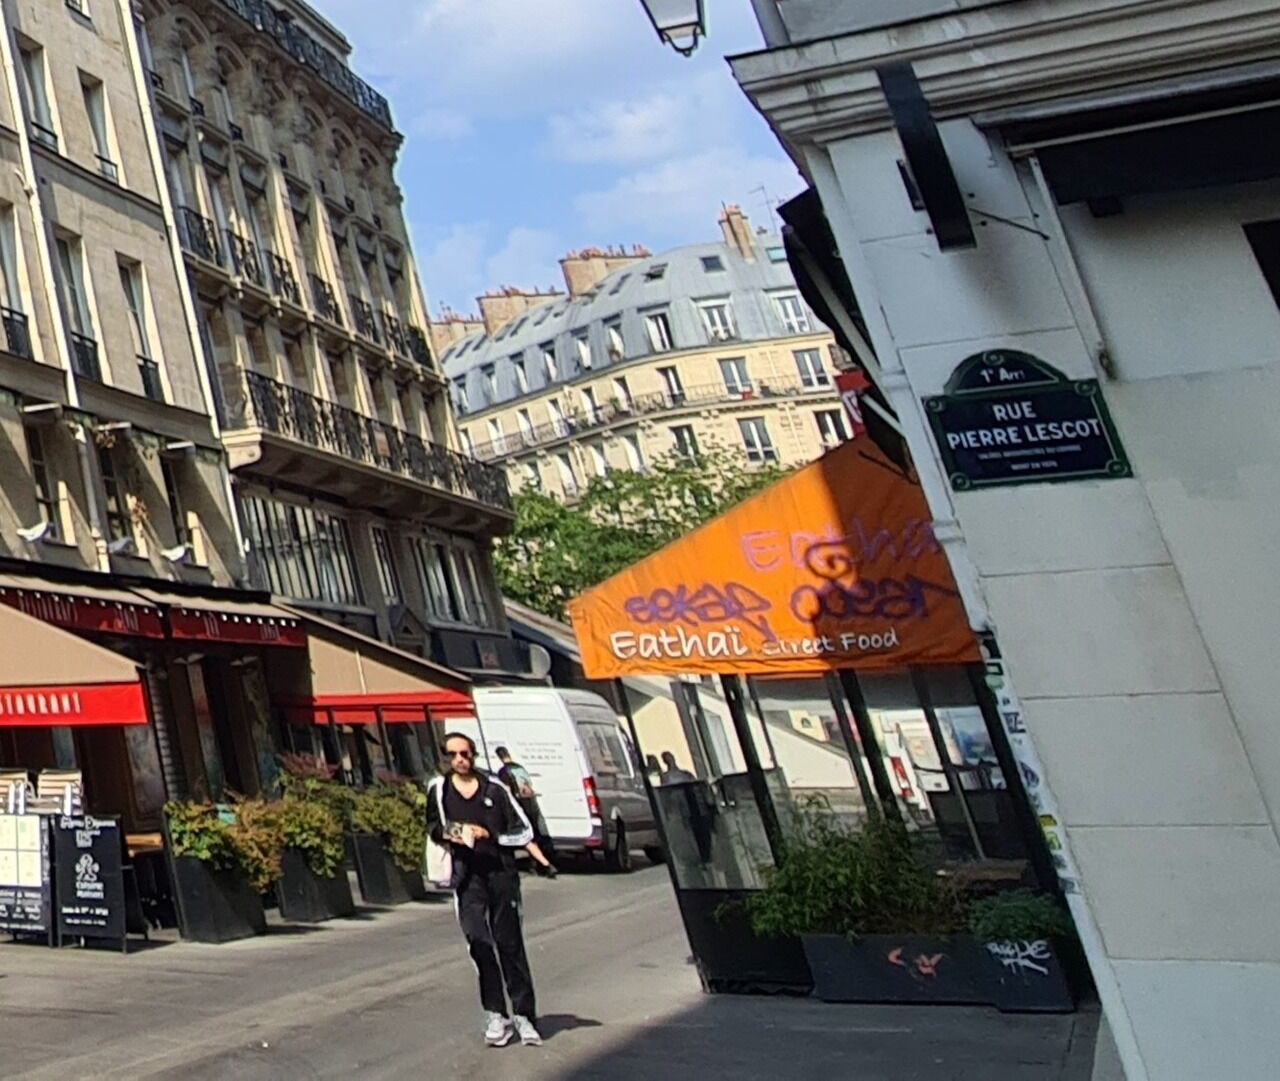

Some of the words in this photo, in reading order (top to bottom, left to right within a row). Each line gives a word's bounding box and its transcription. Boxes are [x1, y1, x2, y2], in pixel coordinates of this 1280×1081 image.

[991, 400, 1037, 422] RUE
[946, 426, 1023, 451] PIERRE
[1023, 418, 1103, 443] LESCOT
[609, 624, 749, 660] Eathaï
[840, 627, 900, 651] Food
